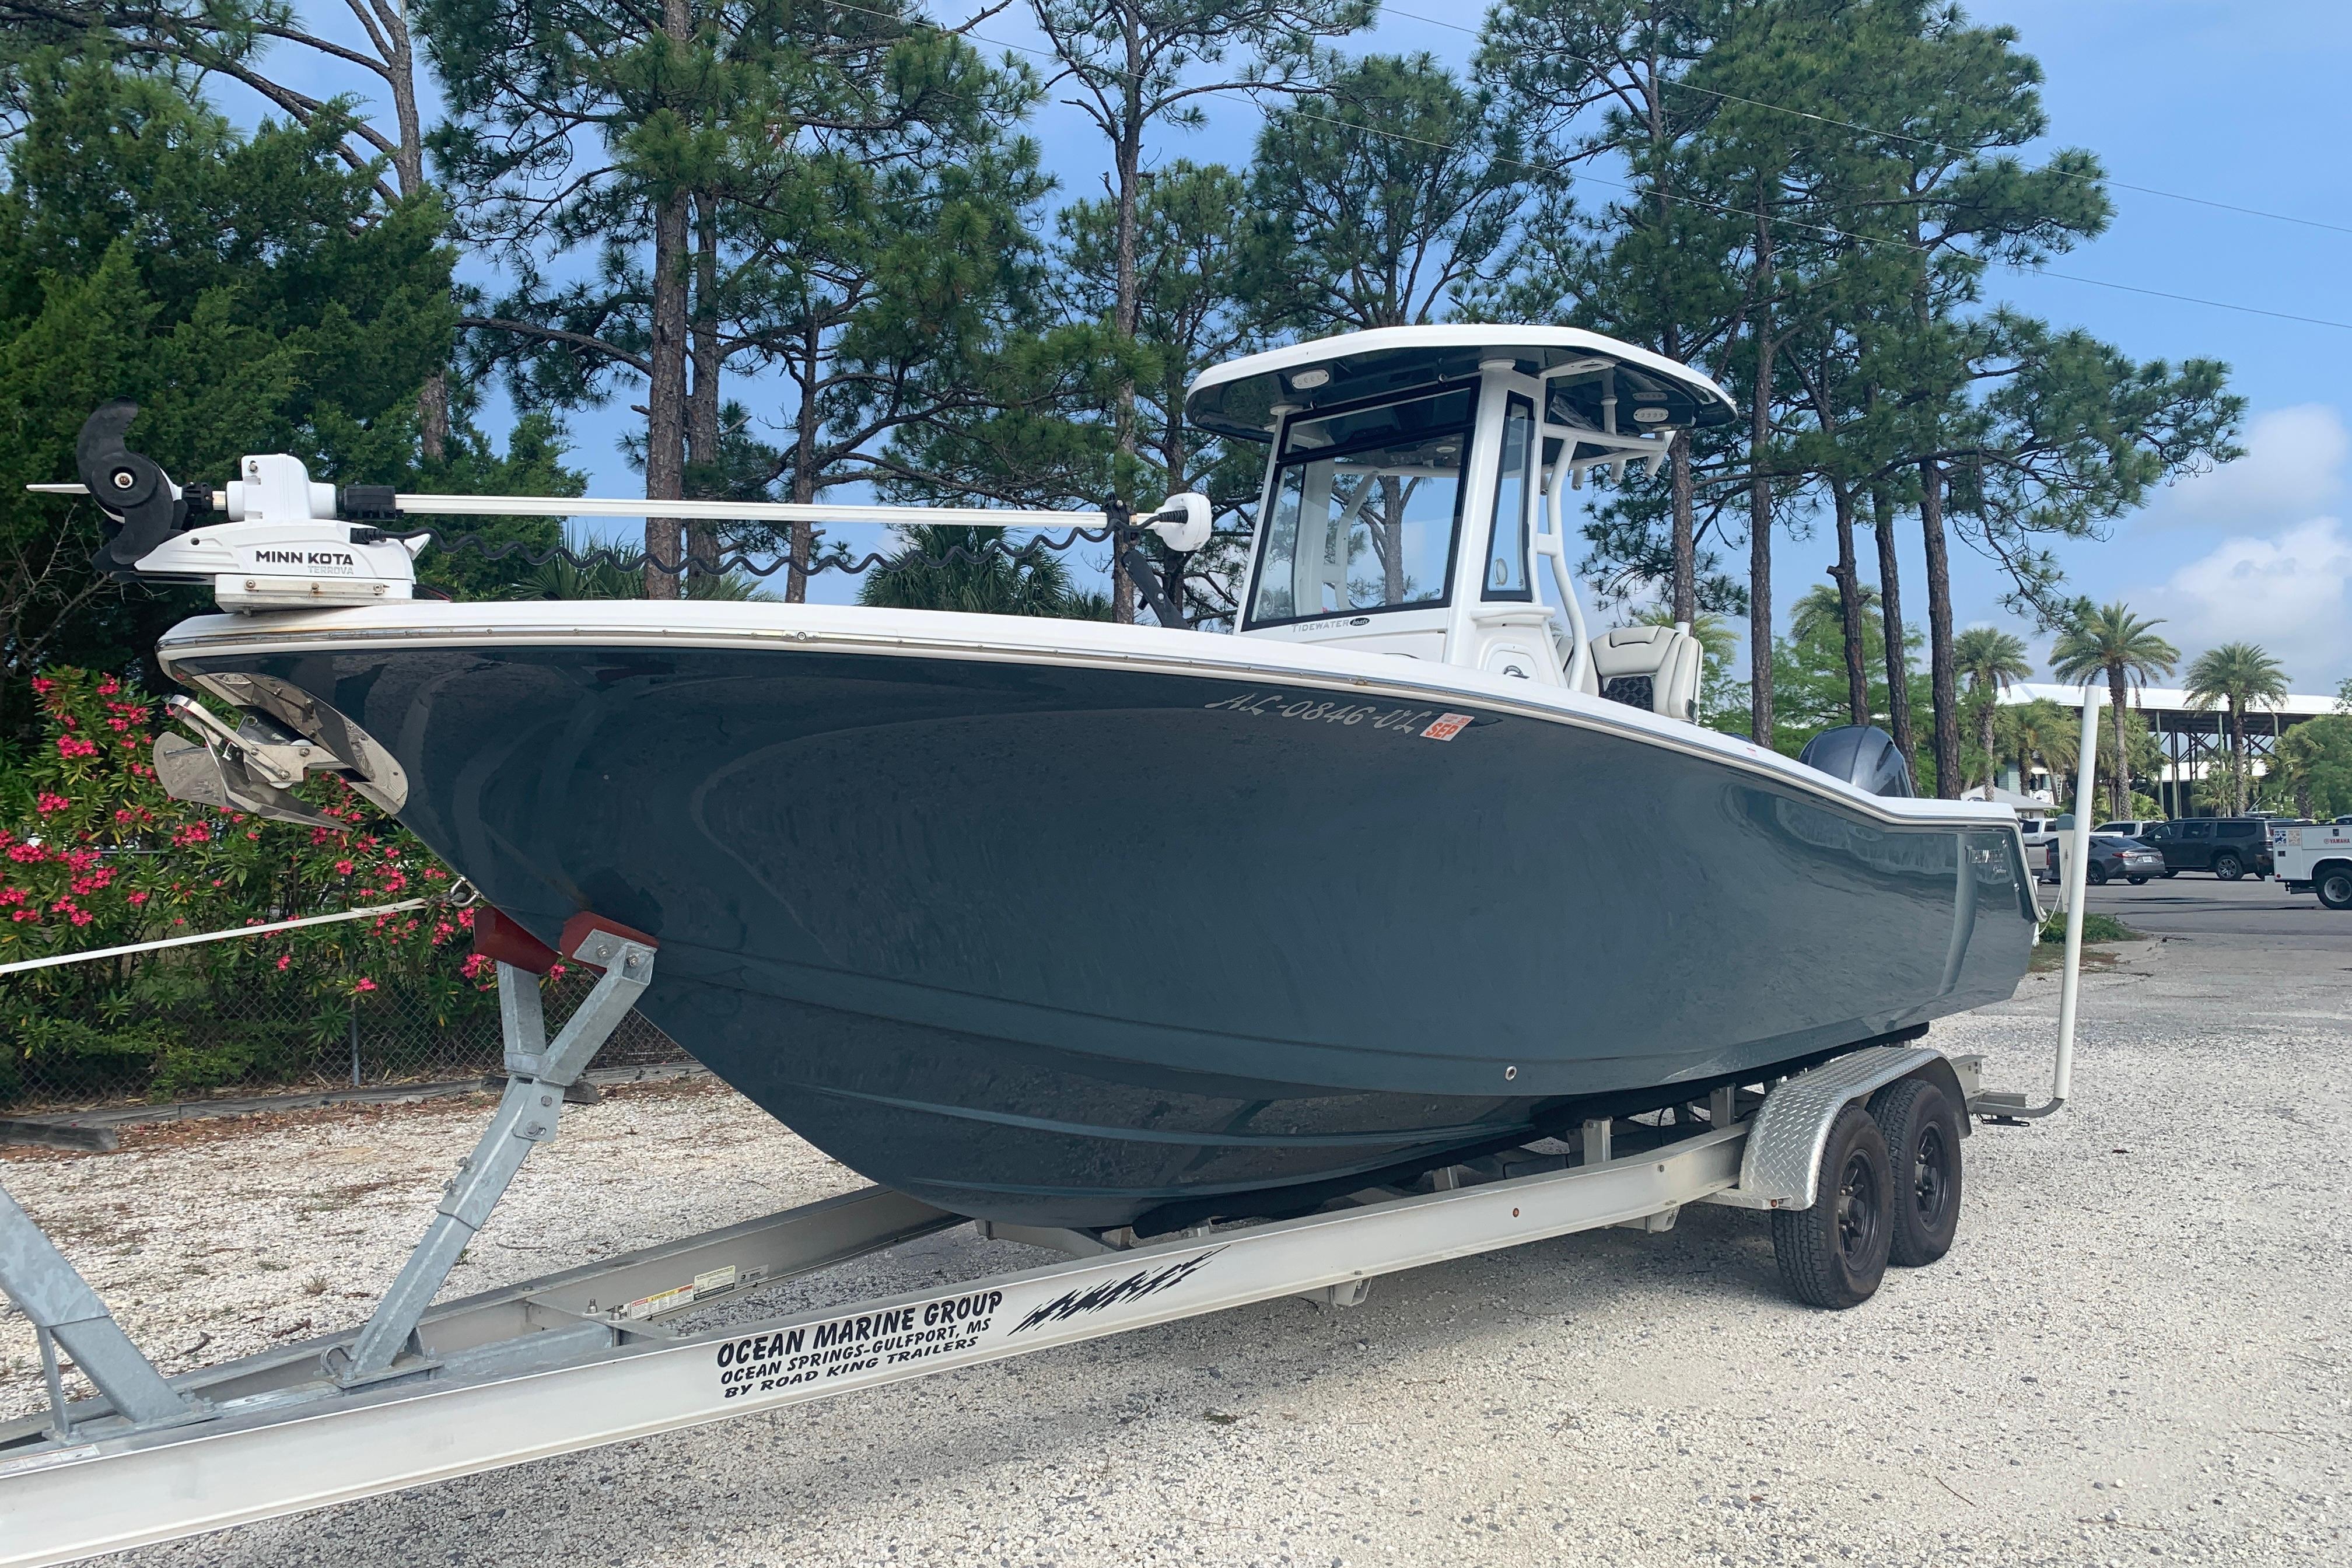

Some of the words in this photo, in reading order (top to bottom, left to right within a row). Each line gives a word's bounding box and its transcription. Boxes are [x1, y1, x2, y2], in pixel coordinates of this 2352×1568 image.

[256, 550, 303, 564] MINN
[308, 552, 354, 565] KOTA
[307, 565, 354, 575] TERROVA
[1426, 722, 1459, 738] SEP
[717, 1329, 806, 1368] OCEAN
[813, 1307, 916, 1349] MARINE
[924, 1291, 1003, 1326] GROUP
[721, 1360, 782, 1385] OCEAN
[787, 1325, 960, 1371] SPRINGS-GULFPORT,
[966, 1317, 992, 1335] MS
[724, 1383, 753, 1398] BY
[760, 1371, 819, 1391] ROAD
[826, 1357, 879, 1377] KING
[886, 1336, 979, 1364] TRAILERS
